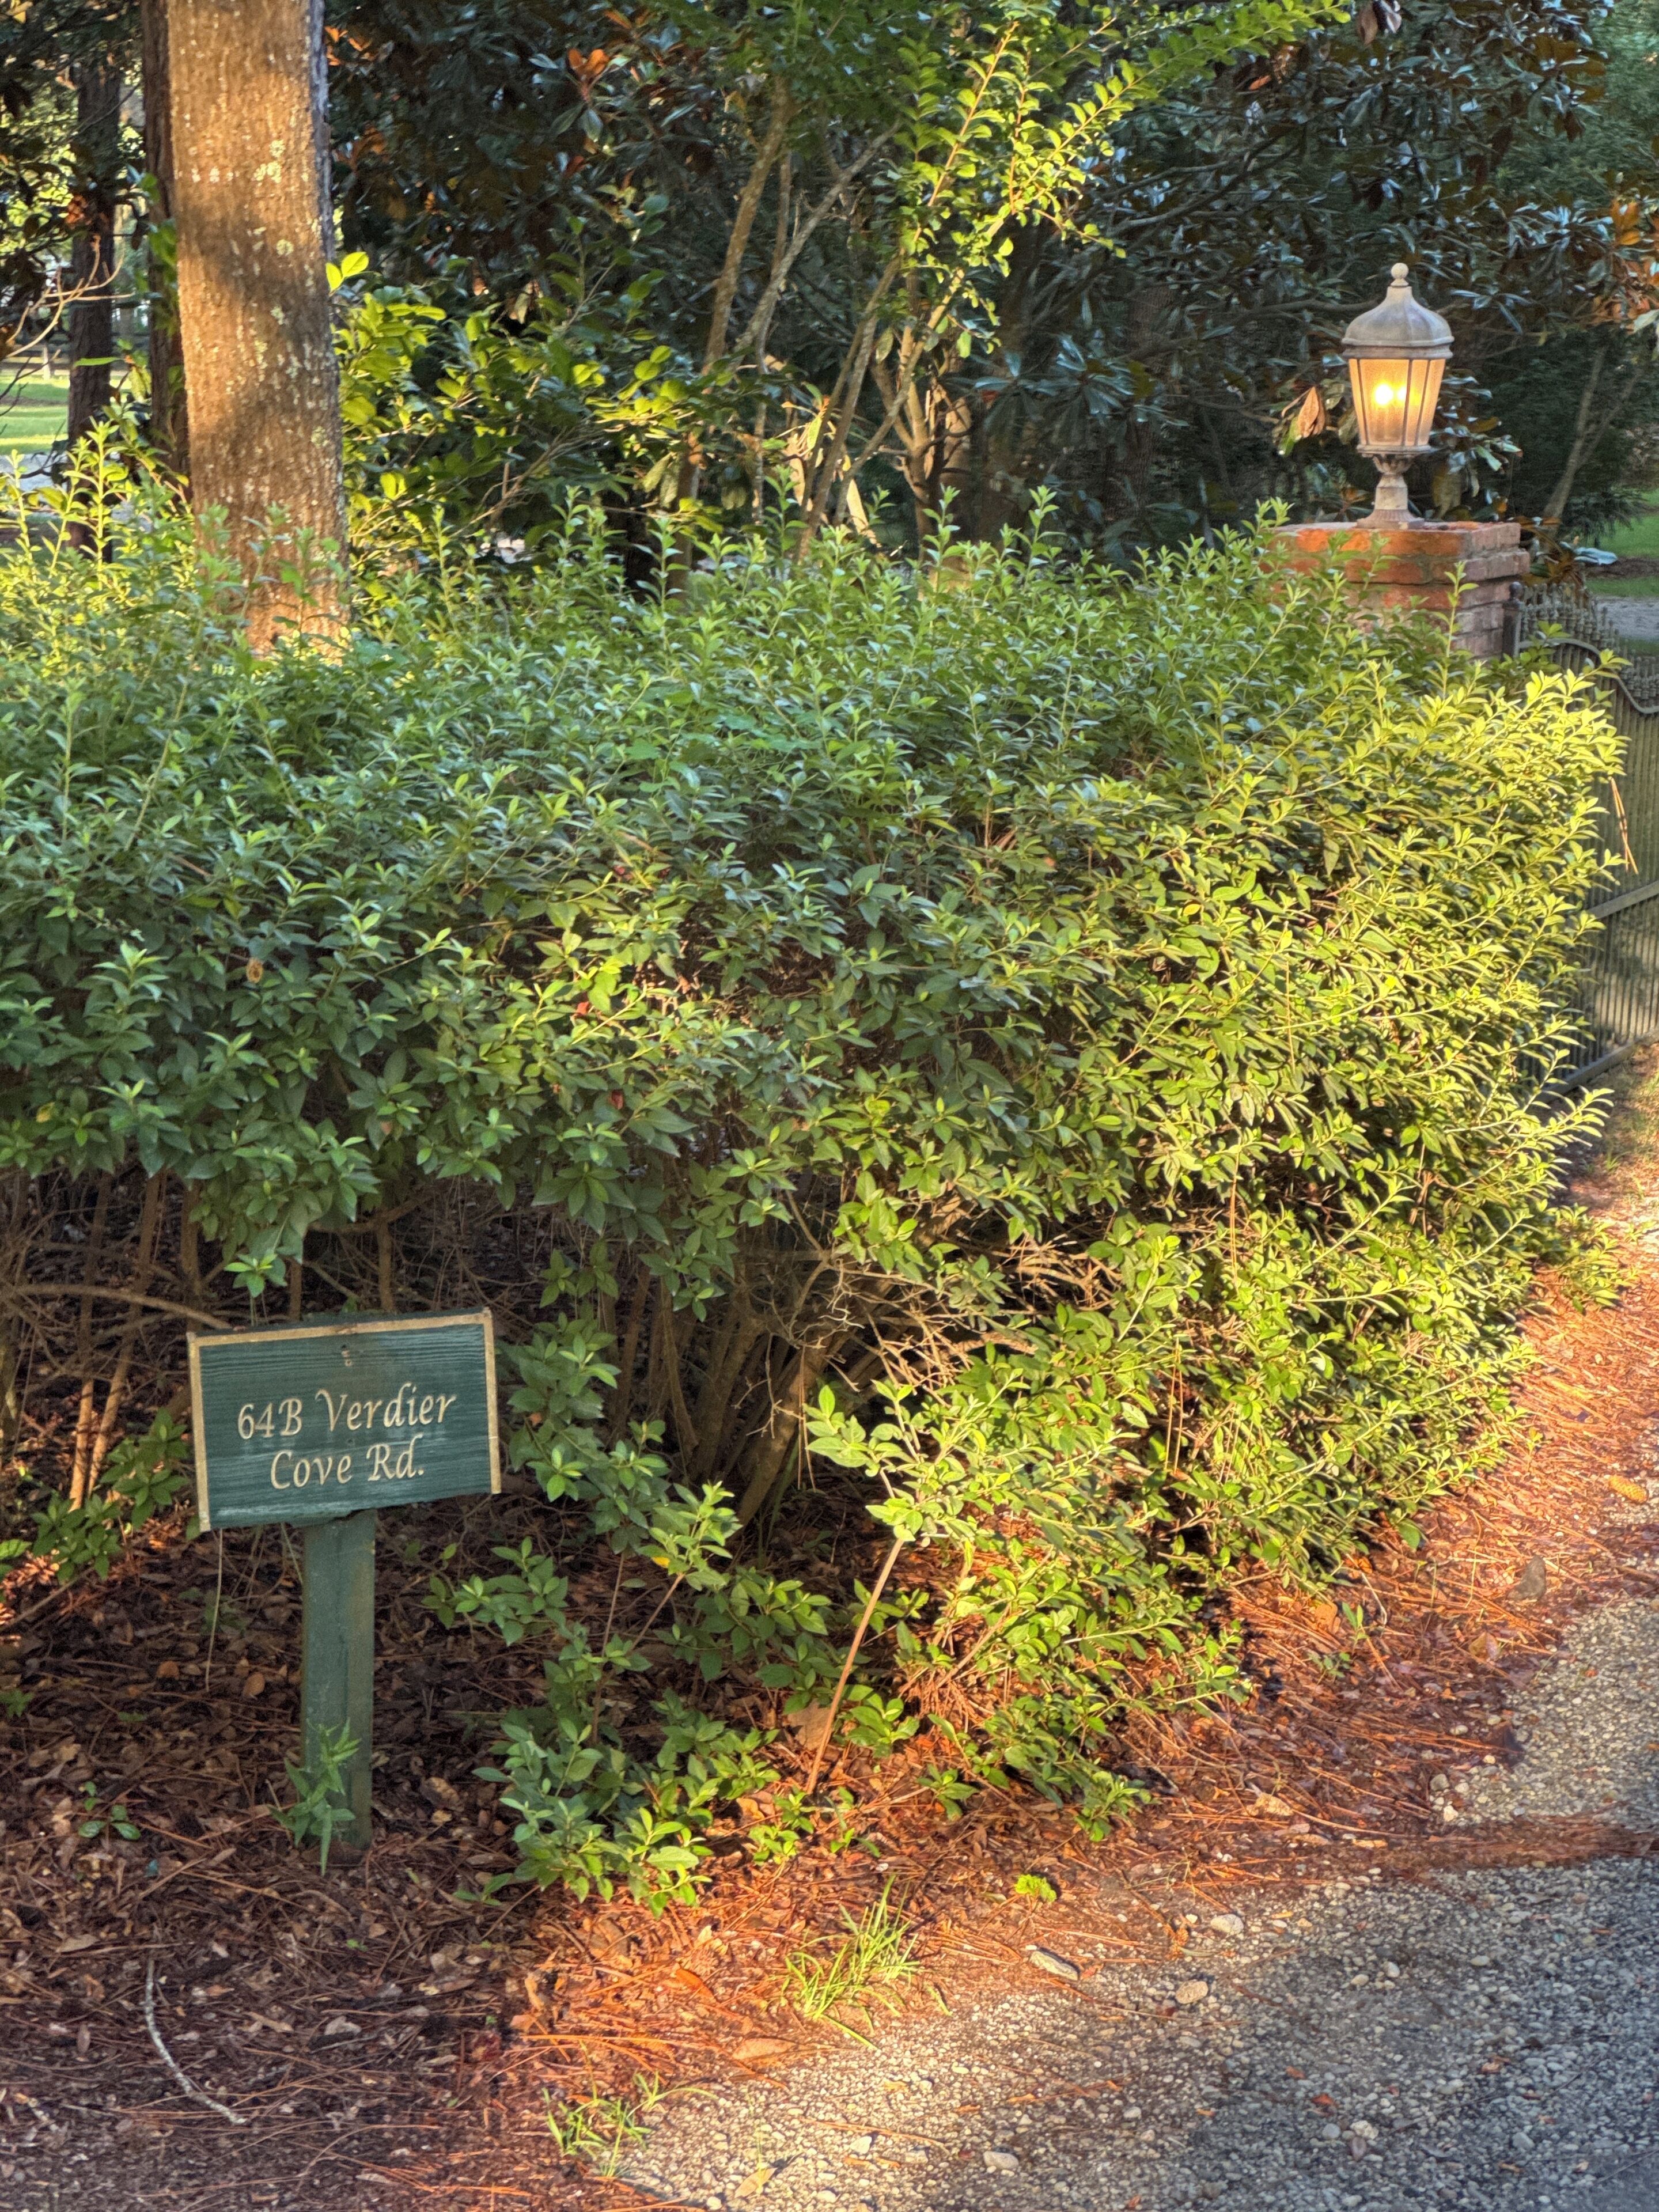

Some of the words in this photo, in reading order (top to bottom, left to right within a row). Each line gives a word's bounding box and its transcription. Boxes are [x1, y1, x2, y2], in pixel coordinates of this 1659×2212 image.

[237, 1397, 303, 1440] 64B
[315, 1382, 457, 1432] Verdier
[270, 1449, 353, 1490] Cove
[366, 1432, 425, 1482] Rd.
